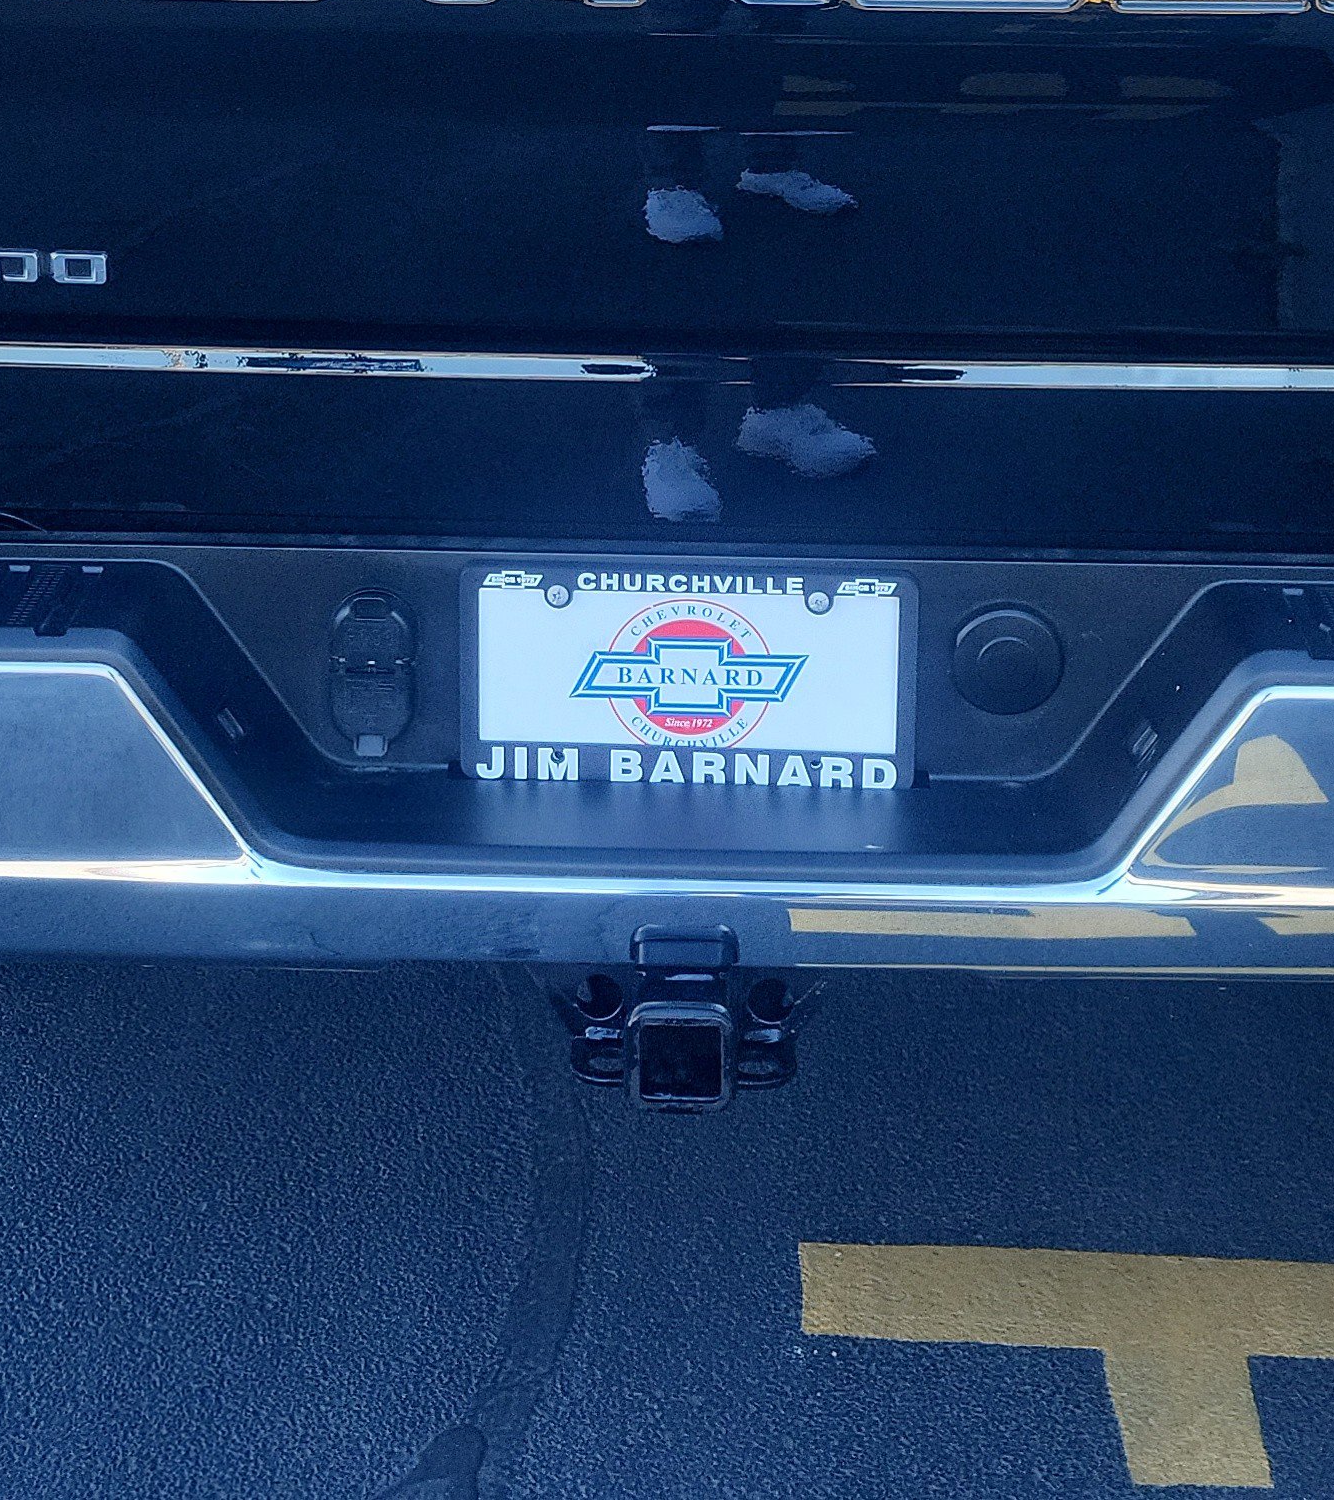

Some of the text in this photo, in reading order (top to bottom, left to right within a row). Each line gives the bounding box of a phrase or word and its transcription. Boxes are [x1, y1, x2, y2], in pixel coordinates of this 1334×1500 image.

[577, 572, 804, 595] CHURCHVILLE
[630, 605, 752, 639] CHEVROLET
[617, 666, 763, 687] BARNARD
[664, 717, 713, 728] Since 1972
[476, 746, 898, 791] JIM BARNARD
